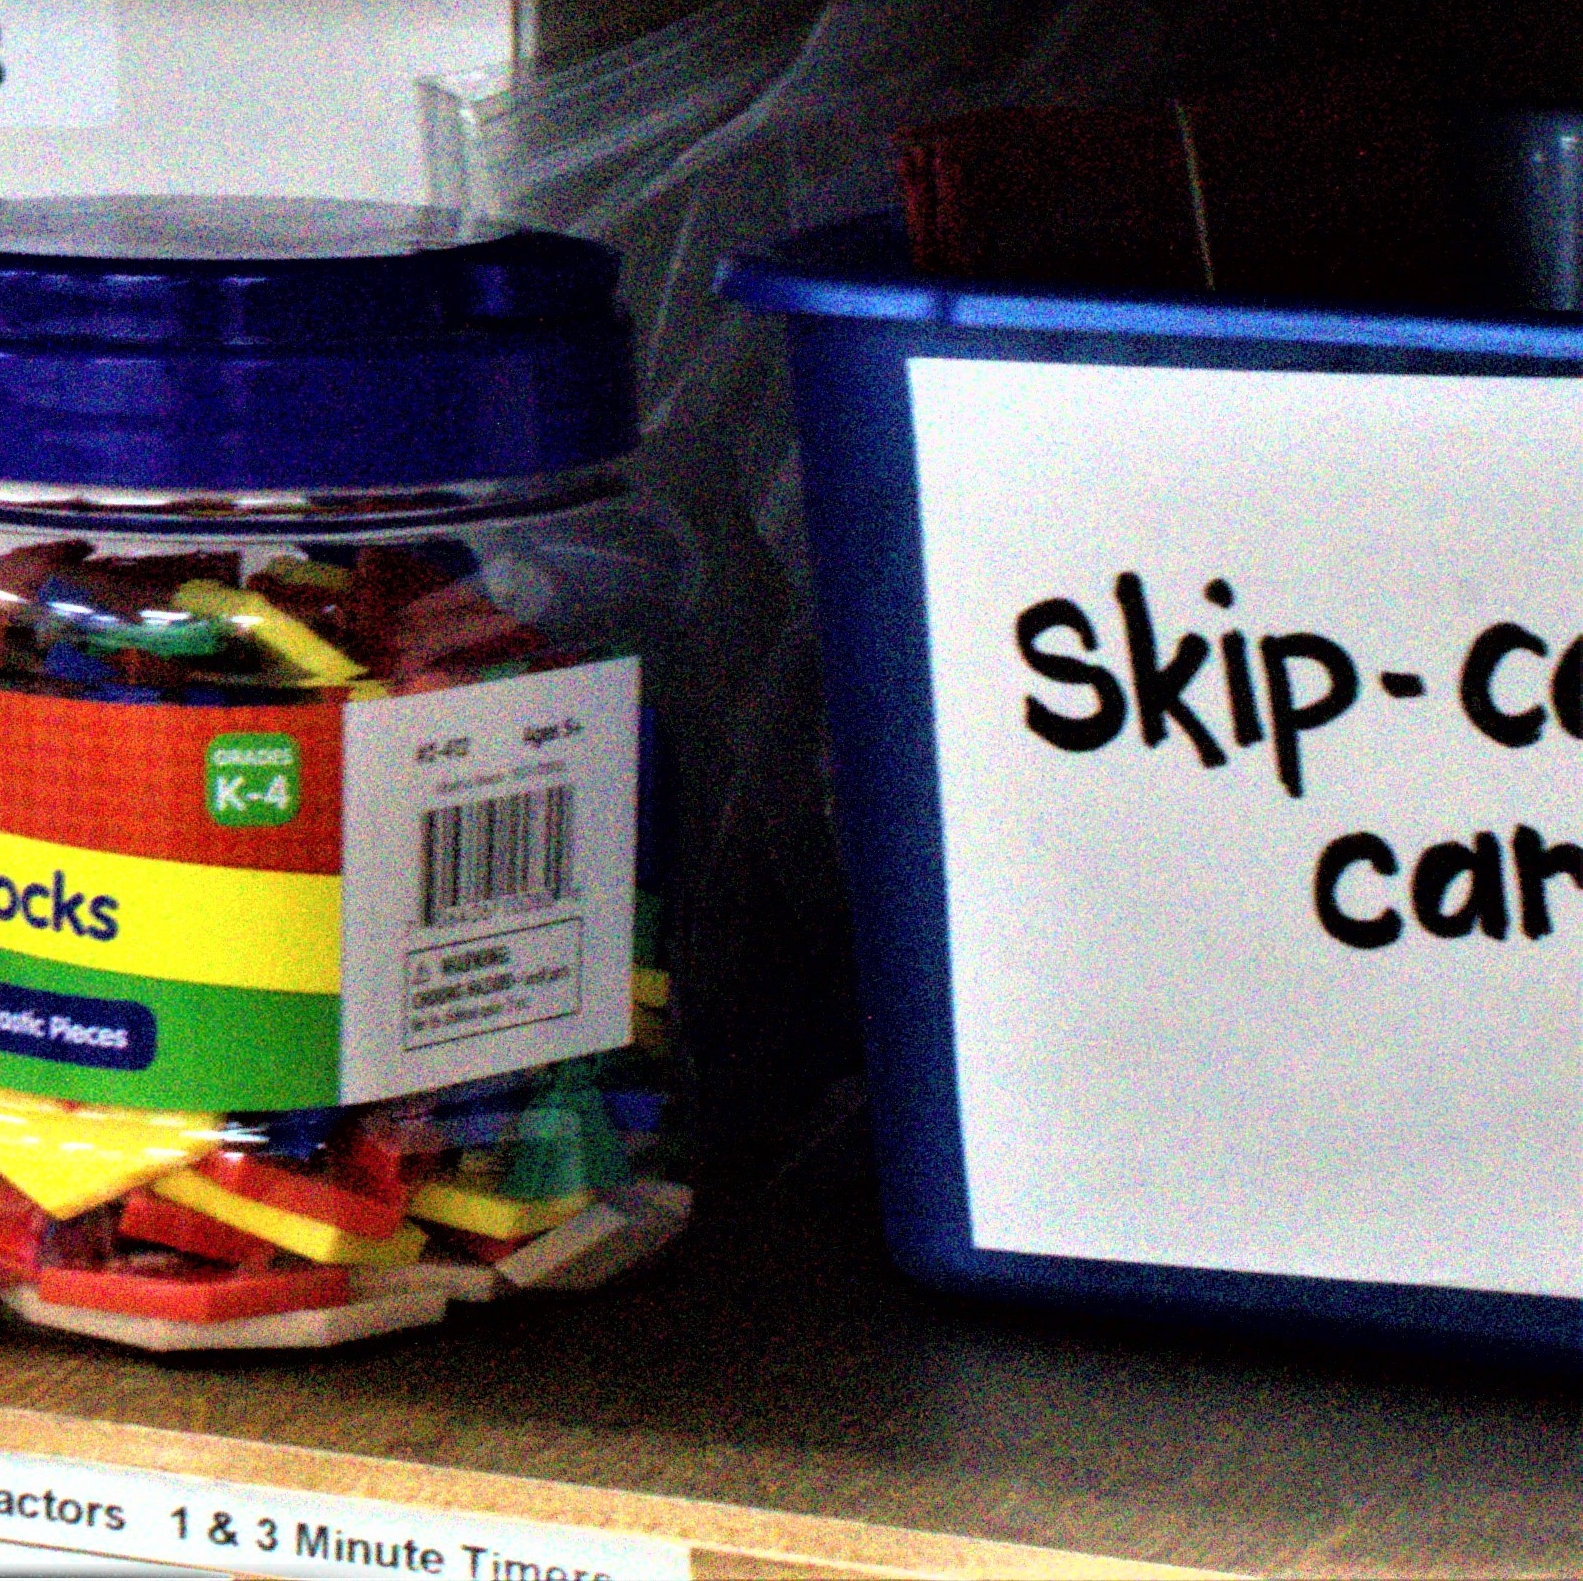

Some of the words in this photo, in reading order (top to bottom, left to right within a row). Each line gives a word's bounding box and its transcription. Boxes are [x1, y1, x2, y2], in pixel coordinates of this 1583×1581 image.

[215, 774, 291, 812] K-4
[49, 1016, 128, 1049] Pieces
[169, 1505, 189, 1540] 1
[207, 1510, 239, 1547] &
[255, 1517, 279, 1552] 3
[294, 1520, 445, 1574] Minute
